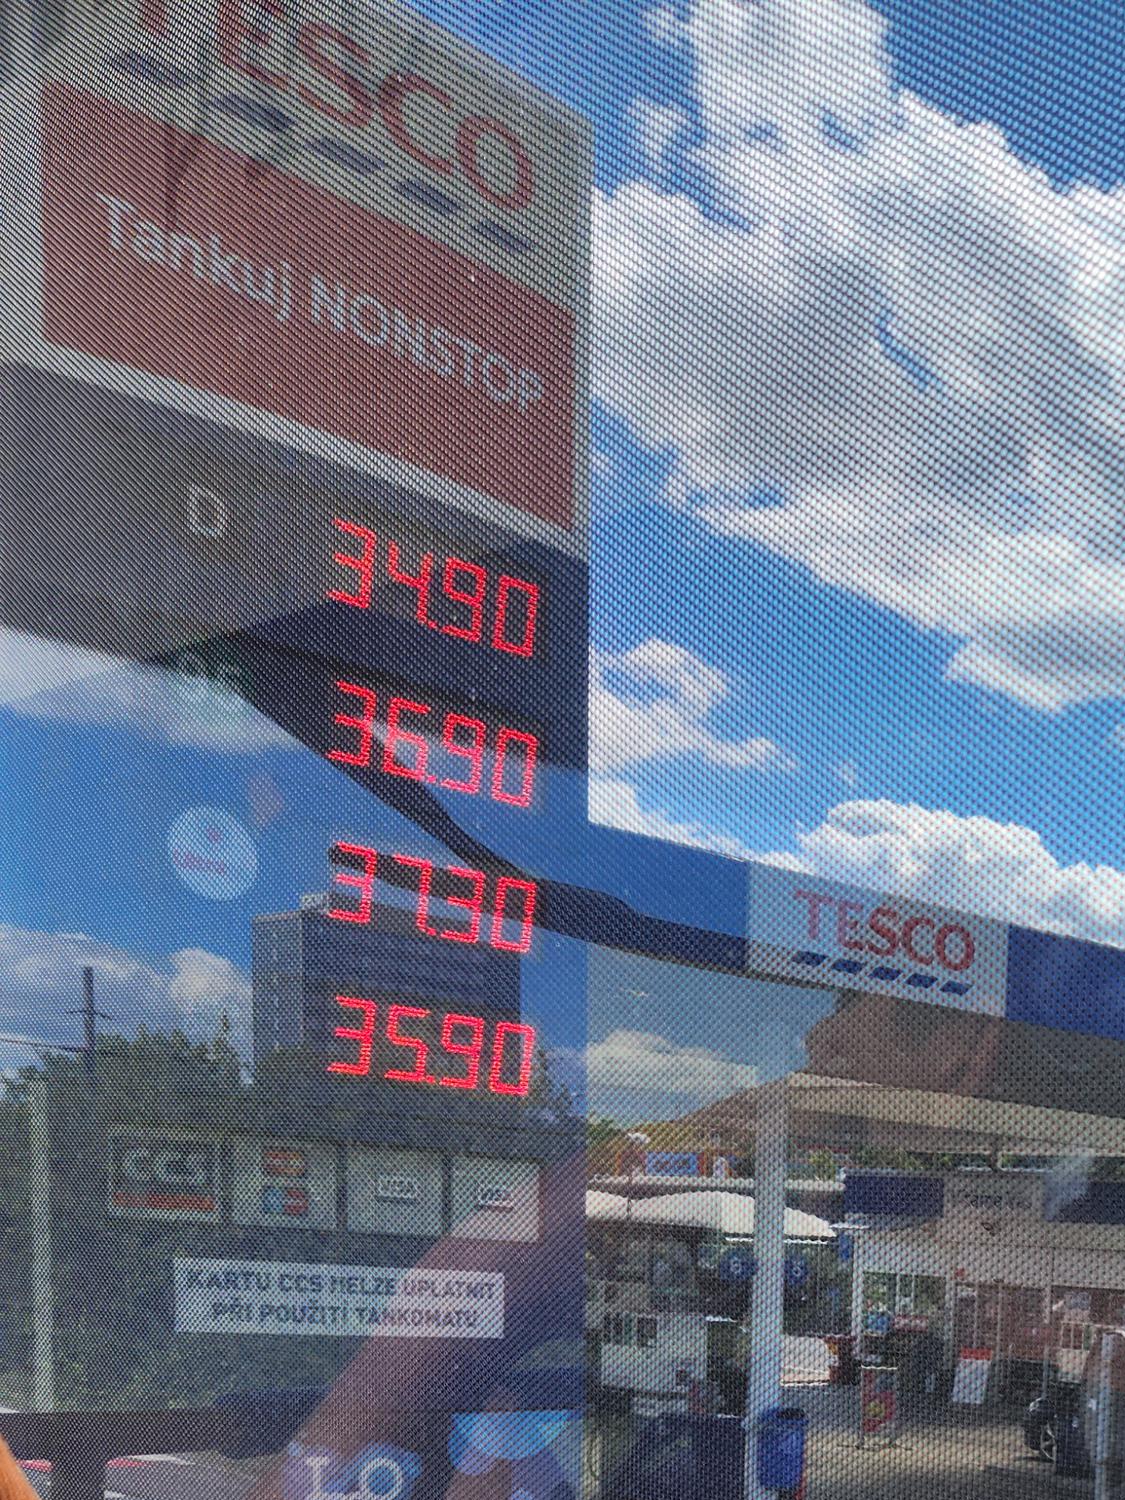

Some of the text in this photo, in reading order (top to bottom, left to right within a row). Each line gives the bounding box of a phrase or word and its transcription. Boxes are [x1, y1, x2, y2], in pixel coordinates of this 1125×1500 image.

[95, 193, 547, 414] Tankuj NONSTOP
[184, 483, 230, 540] D
[793, 888, 976, 973] TESCO
[185, 1270, 272, 1292] KARTU
[277, 1273, 324, 1295] CCS
[329, 1275, 397, 1297] NELZE
[355, 1305, 478, 1328] TANKOMATU
